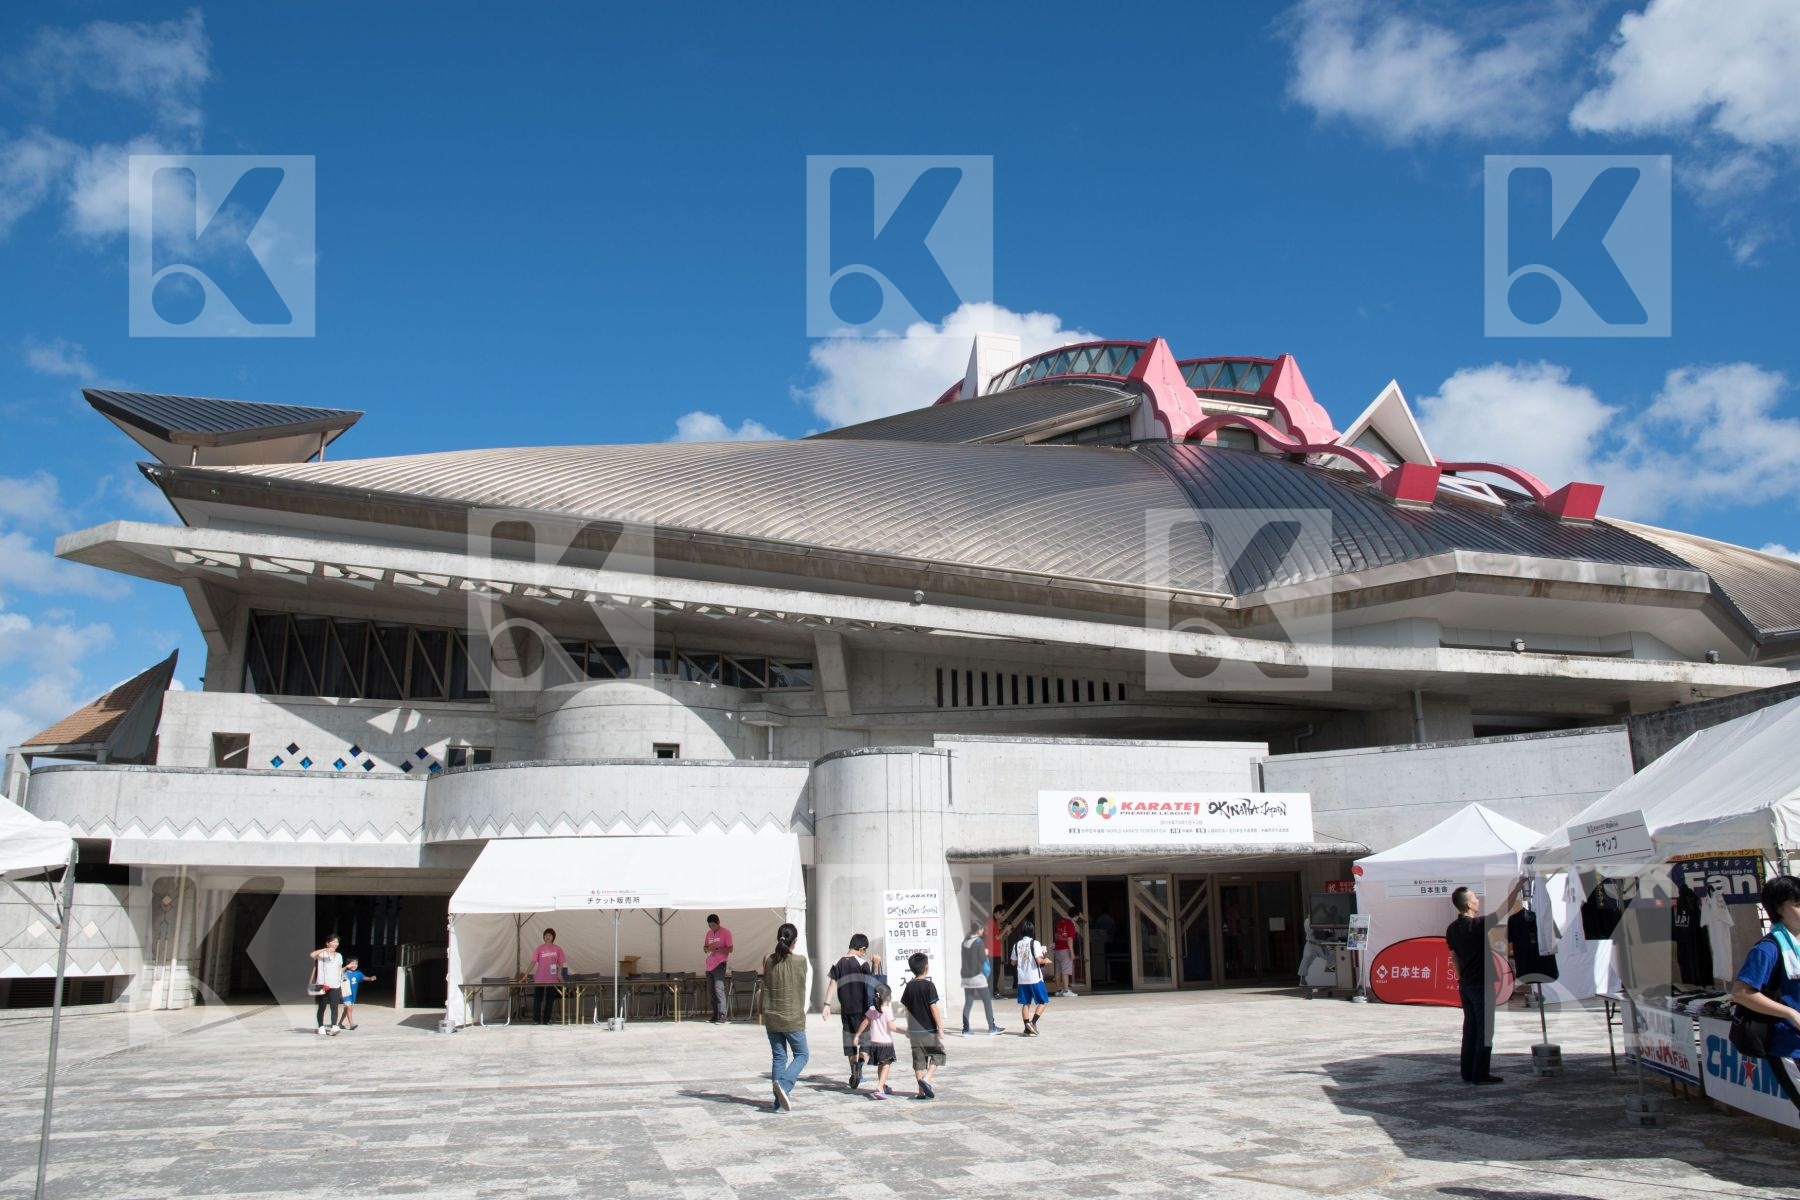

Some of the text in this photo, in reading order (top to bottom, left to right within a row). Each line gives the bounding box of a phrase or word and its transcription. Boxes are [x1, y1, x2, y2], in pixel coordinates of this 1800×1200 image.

[1121, 802, 1200, 815] KARATE1
[1595, 835, 1618, 852] チャンプ
[1420, 886, 1448, 894] 日本生命
[587, 896, 640, 905] チケット販売所
[898, 920, 927, 929] 2016年
[1391, 964, 1431, 979] 日本生命
